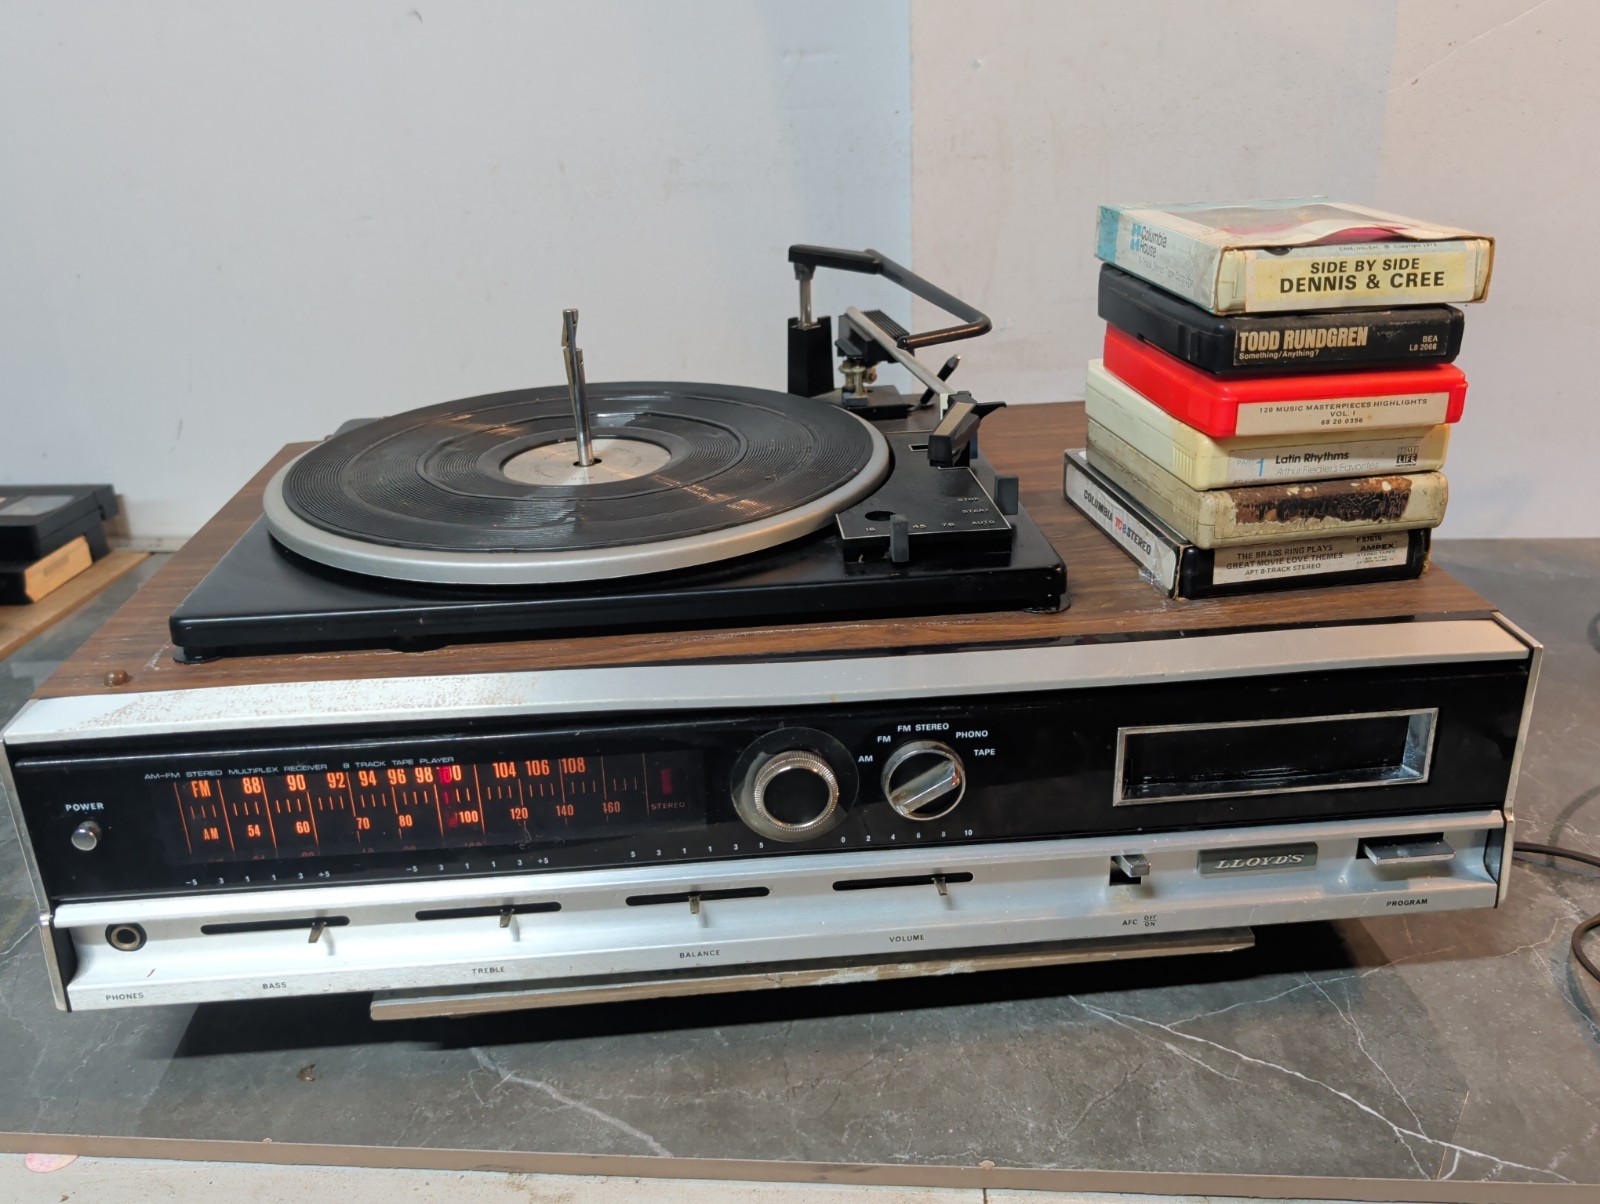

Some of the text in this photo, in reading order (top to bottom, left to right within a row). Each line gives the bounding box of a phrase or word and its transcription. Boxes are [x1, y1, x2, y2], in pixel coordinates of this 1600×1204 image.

[1142, 226, 1167, 248] Columbia
[1140, 241, 1157, 259] House
[1310, 258, 1420, 274] SIDE BY SIDE
[1280, 271, 1445, 293] DENNIS & CREE
[1239, 326, 1369, 352] TODD RUNDGREN
[1239, 349, 1319, 360] Something/Anything?
[1306, 401, 1371, 411] MASTERPIECES
[1373, 398, 1427, 407] HIGHLIGHTS
[1275, 452, 1348, 464] Latin Rhythms
[1396, 454, 1417, 463] LIFE
[1256, 458, 1264, 477] 1
[1083, 490, 1113, 522] COLUMBIA
[1237, 544, 1333, 560] THE BRASS RING PLAYS
[1360, 543, 1394, 551] AMPEX
[1227, 552, 1344, 569] GREAT MOVIE LOVE THEMES
[1293, 563, 1321, 571] STEREO
[877, 735, 891, 743] FM
[915, 722, 949, 731] STEREO
[956, 729, 988, 738] PHONO
[974, 748, 996, 756] TAPE
[144, 772, 180, 780] AM-FM
[186, 769, 223, 778] STEREO
[228, 766, 279, 775] MULTIPLEX
[283, 763, 327, 772] RECEIVER
[355, 760, 386, 768] TRACK
[391, 758, 414, 766] TAPE
[419, 756, 455, 764] PLAYER
[191, 780, 211, 798] FM
[242, 777, 261, 794] 88
[286, 774, 306, 791] 90
[327, 772, 346, 789] 92
[358, 770, 377, 787] 94
[387, 768, 406, 785] 96
[415, 766, 433, 783] 98
[493, 762, 517, 778] 104
[525, 760, 550, 776] 106
[562, 757, 586, 774] 108
[65, 802, 104, 812] POWER
[650, 802, 685, 810] STEREO
[203, 801, 621, 840] AM 54 60 70 80 100 120 140 160
[866, 834, 871, 842] 2
[891, 833, 896, 841] 4
[759, 841, 764, 849] 5
[1214, 853, 1305, 869] LLOYD'S
[298, 872, 304, 880] 3
[1386, 898, 1428, 907] PROGRAM
[889, 934, 925, 943] VOLUME
[679, 949, 720, 959] BALANCE
[472, 966, 505, 974] TREBLE
[105, 992, 144, 1001] PHONES
